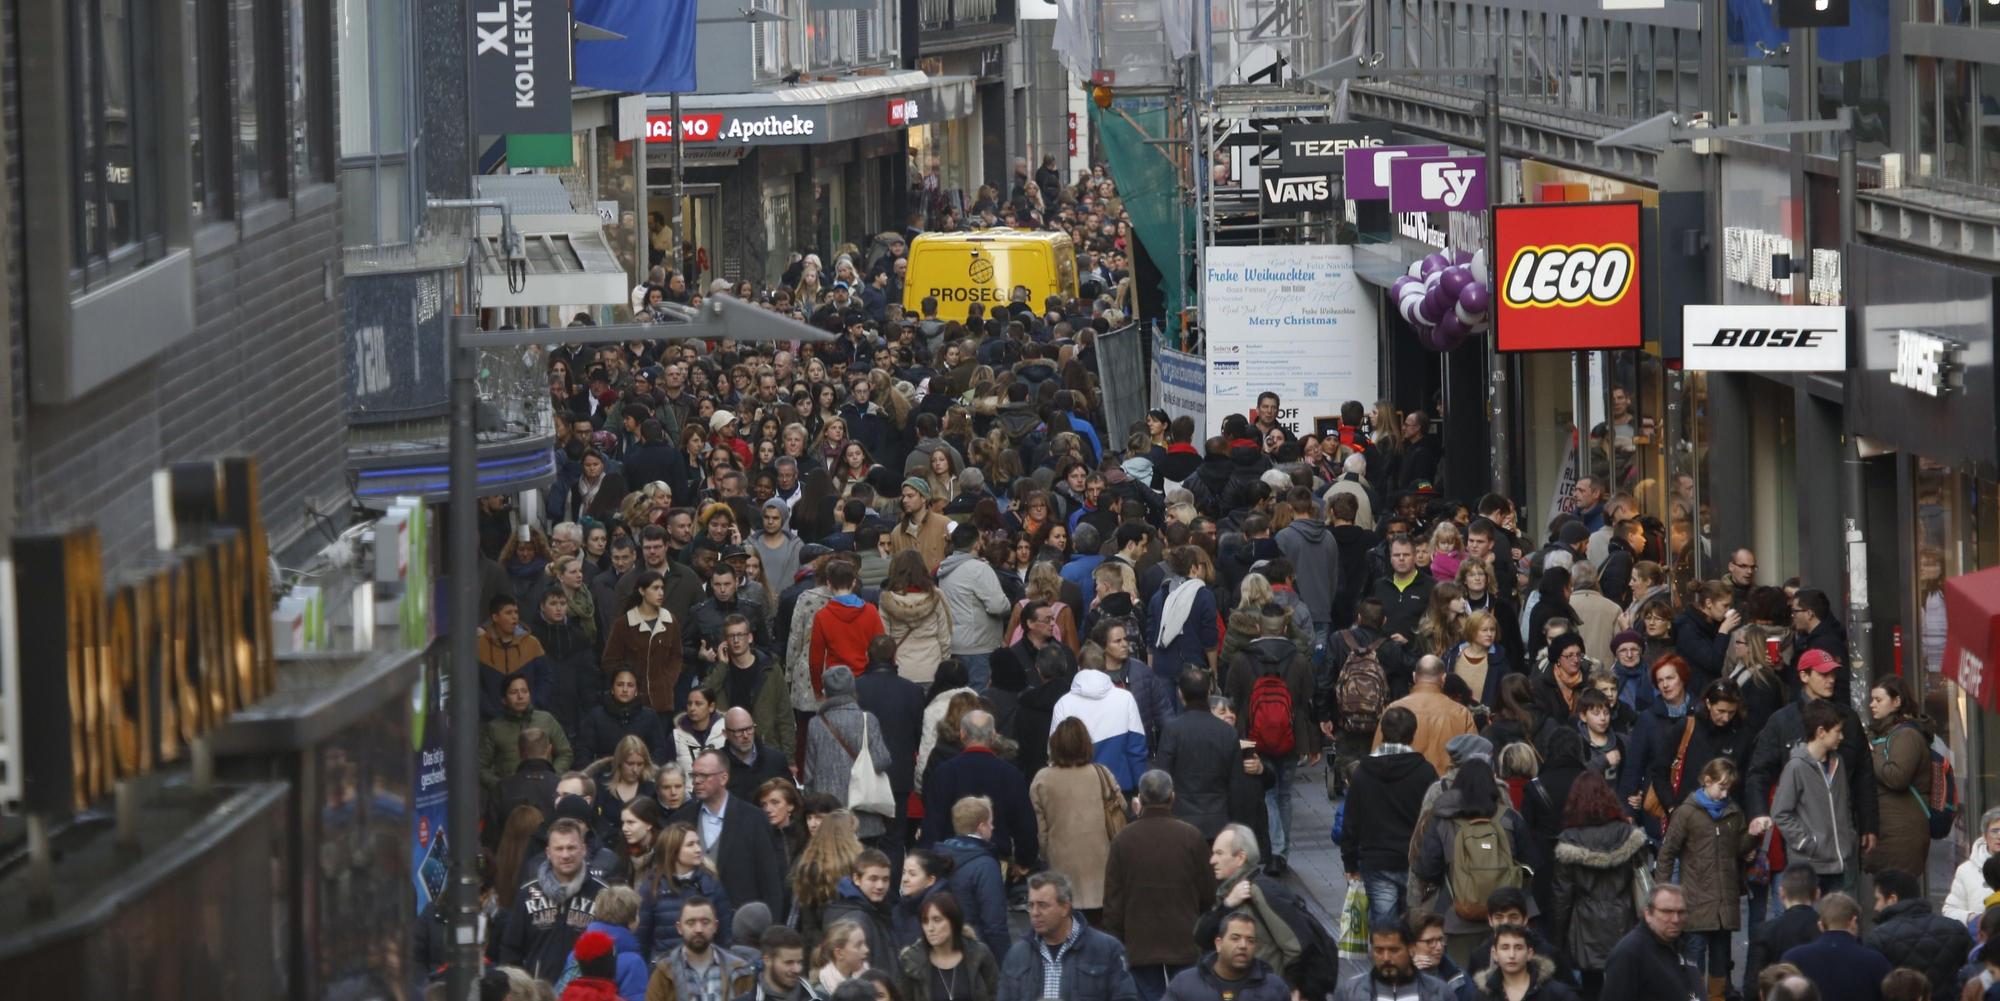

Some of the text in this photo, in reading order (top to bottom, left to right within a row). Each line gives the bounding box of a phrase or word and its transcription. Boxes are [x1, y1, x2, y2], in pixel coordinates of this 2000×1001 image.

[477, 1, 508, 56] XL
[729, 114, 815, 143] Apotheke
[1264, 175, 1329, 204] VANS
[1207, 267, 1315, 283] Frohe Weihnachten
[1508, 248, 1629, 303] LEGO
[1249, 315, 1338, 327] Merry Christmas
[1693, 328, 1838, 348] BOSE
